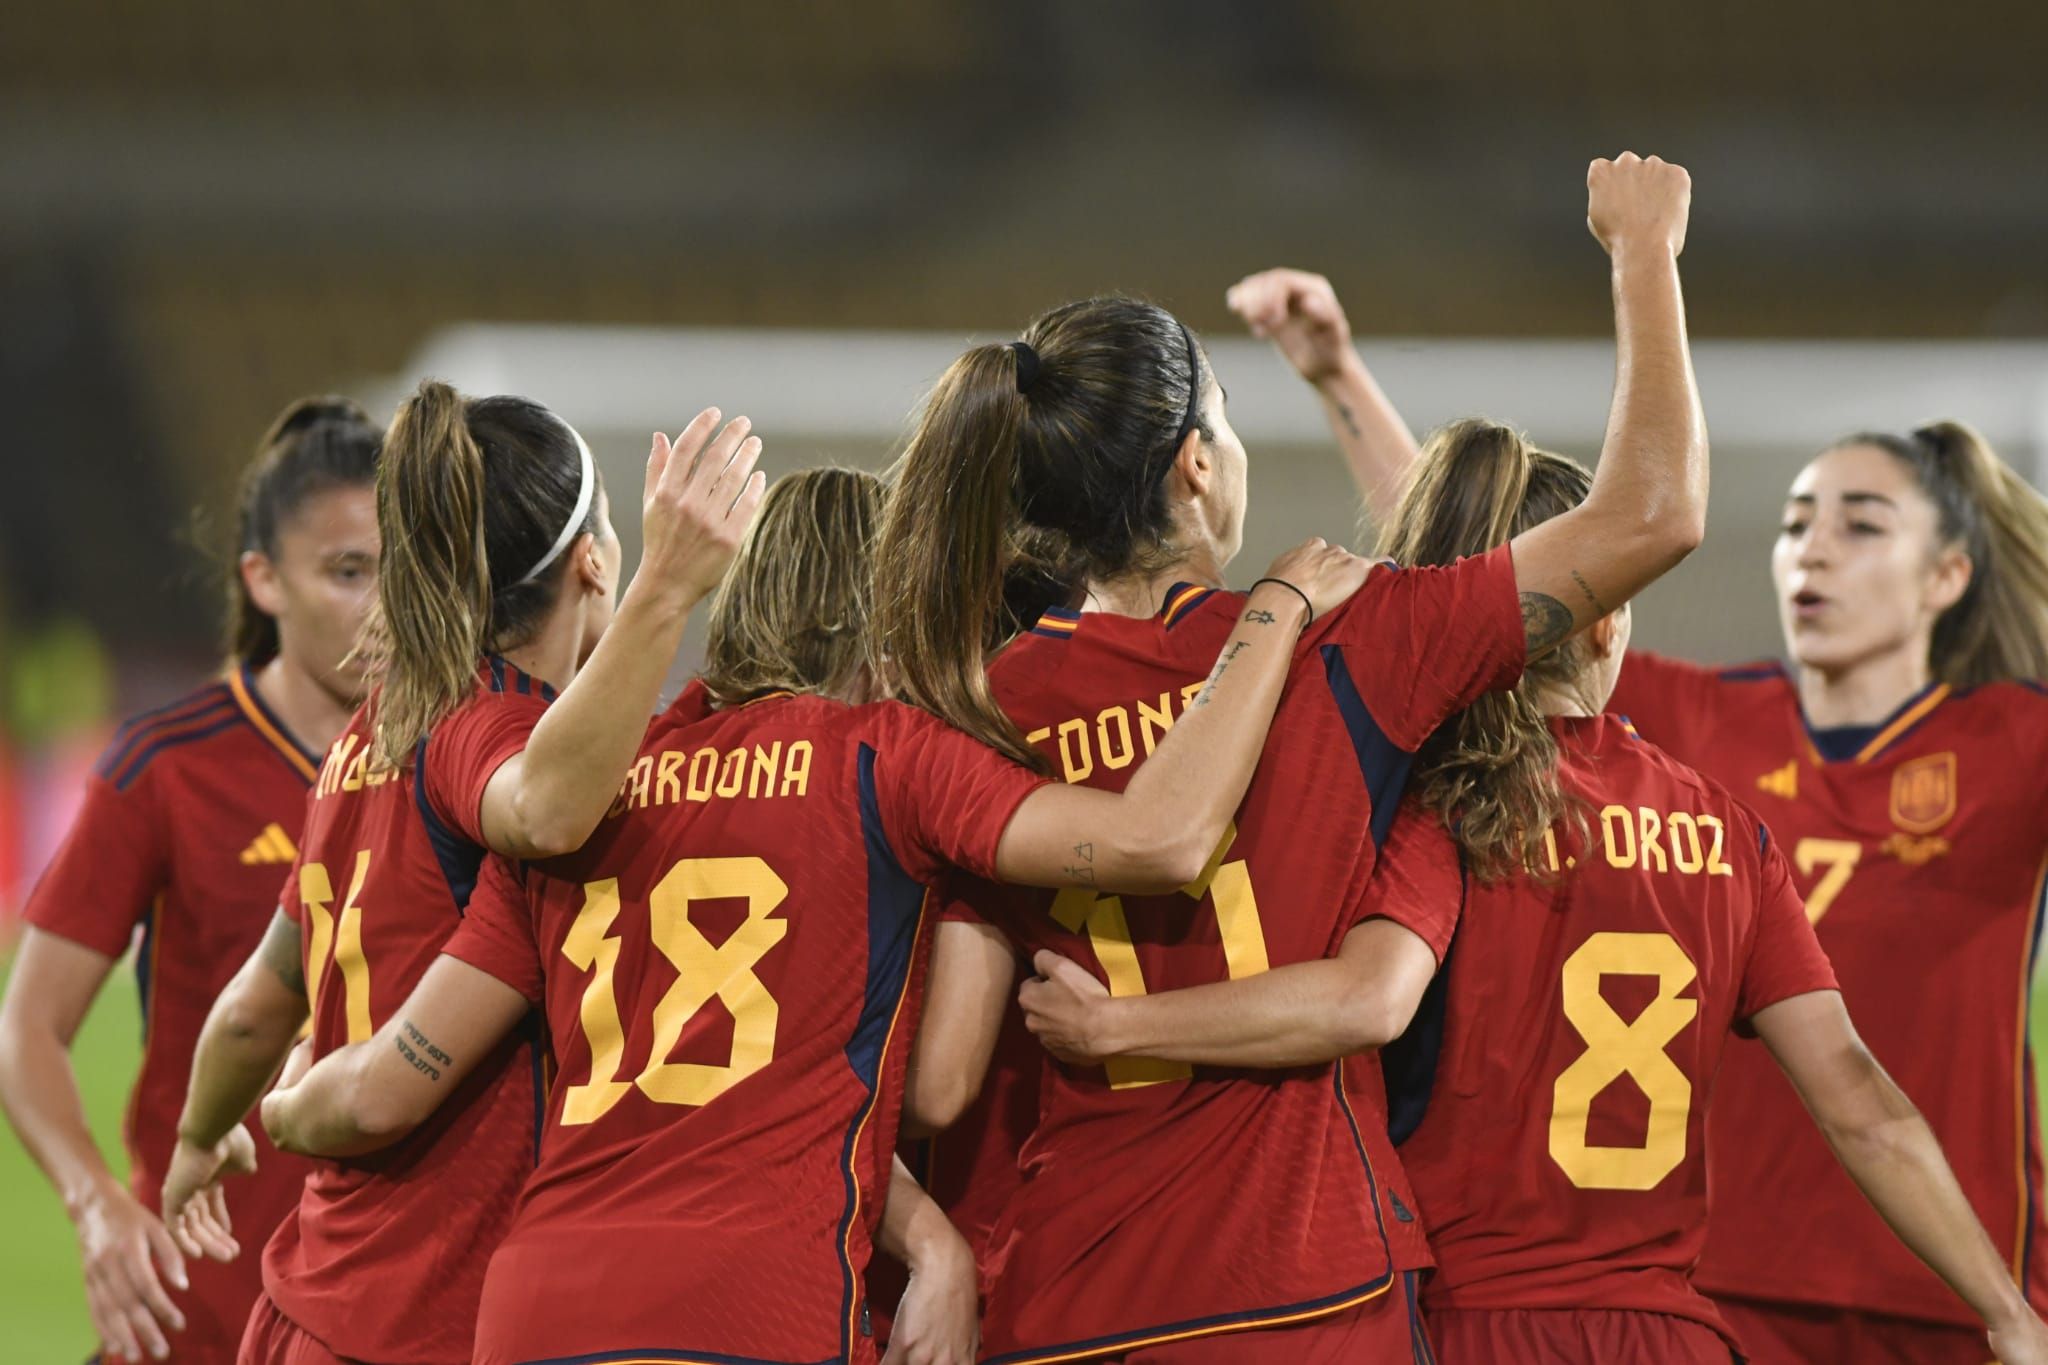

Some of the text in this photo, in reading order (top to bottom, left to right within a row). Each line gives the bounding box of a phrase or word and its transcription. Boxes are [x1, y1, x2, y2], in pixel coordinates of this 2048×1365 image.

[1026, 680, 1207, 785] DON
[1600, 804, 1734, 878] OROZ
[1794, 836, 1863, 929] 7
[560, 856, 790, 1127] 18
[1548, 931, 1698, 1191] 8
